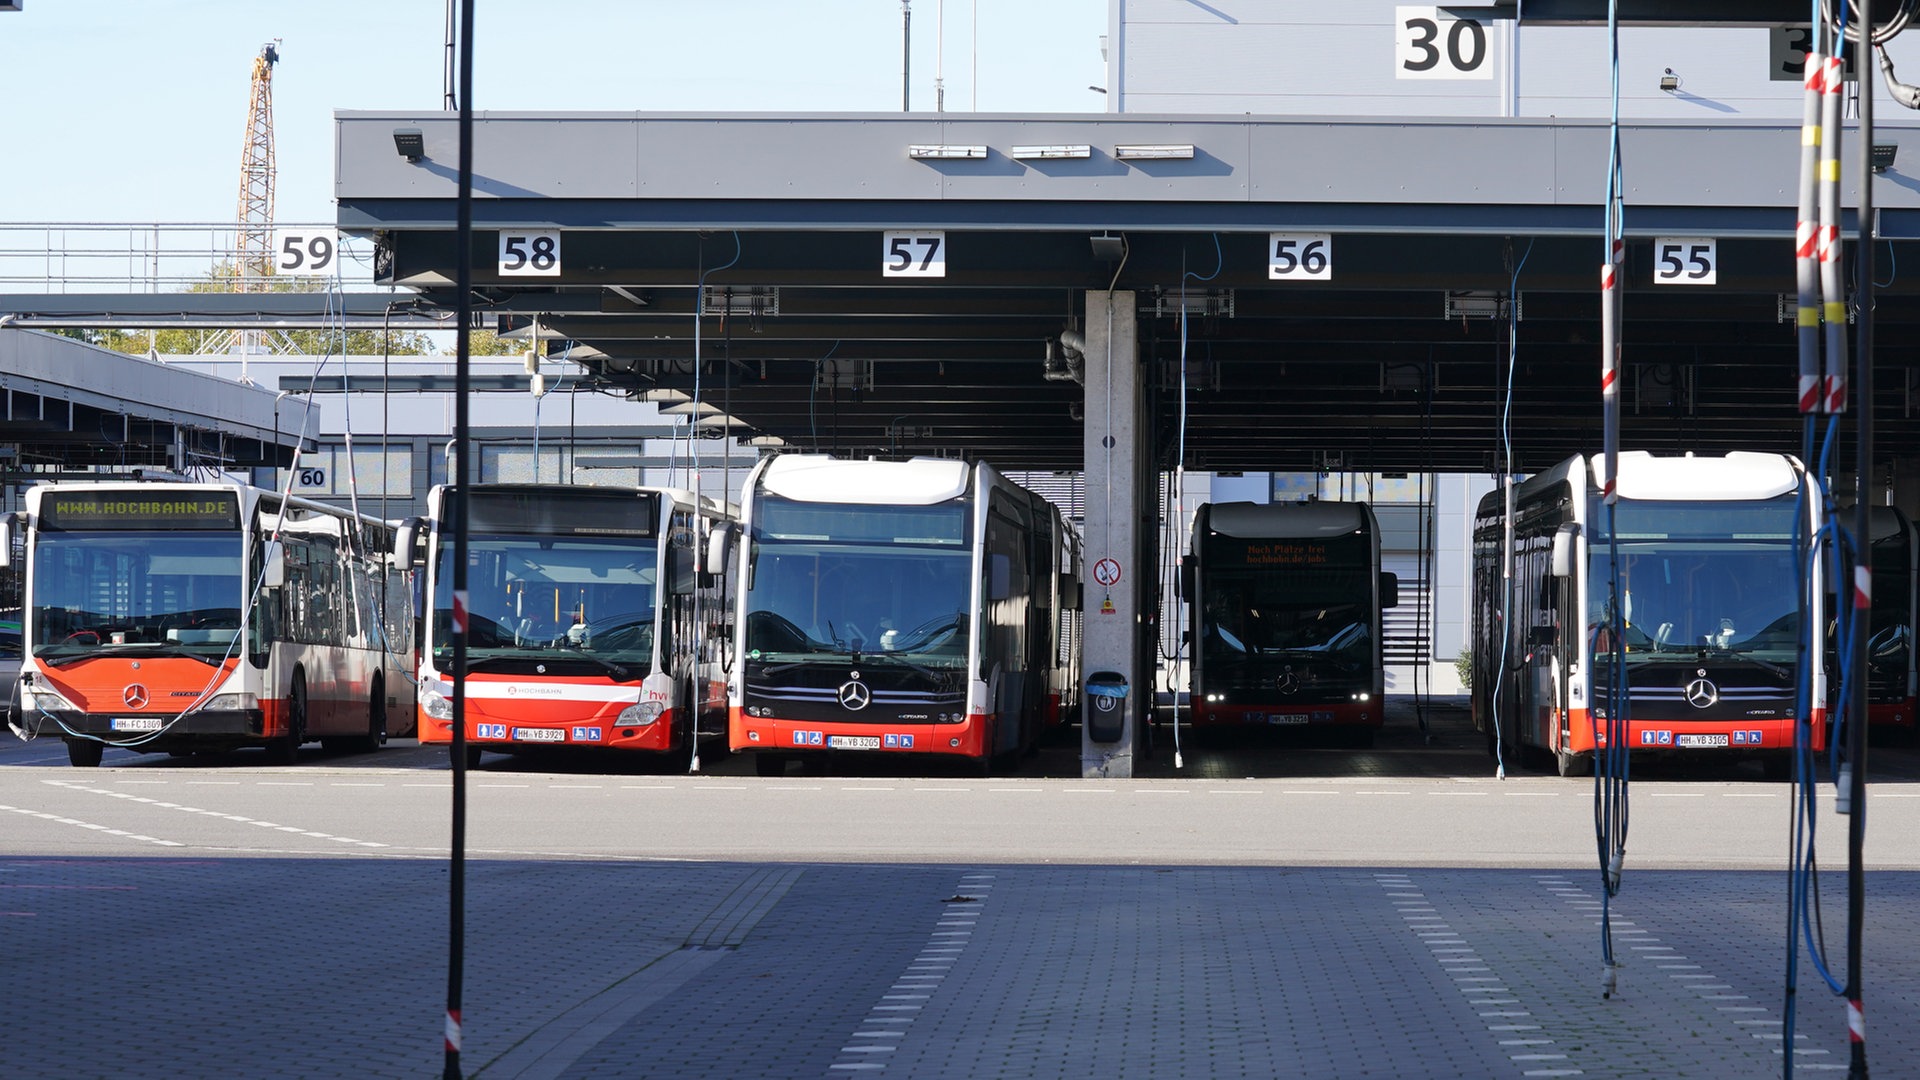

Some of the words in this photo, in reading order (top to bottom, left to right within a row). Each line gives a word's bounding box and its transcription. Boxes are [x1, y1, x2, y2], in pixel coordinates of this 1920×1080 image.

[1404, 18, 1486, 72] 30
[1782, 28, 1853, 74] 3
[281, 236, 332, 270] 59
[504, 236, 556, 270] 58
[889, 238, 941, 272] 57
[1274, 240, 1327, 274] 56
[1660, 245, 1711, 279] 55
[300, 470, 324, 486] 60
[56, 501, 227, 514] WWW.HOCHBAHN.DE
[518, 687, 562, 696] HOCHBAHN
[116, 720, 127, 728] HH
[131, 720, 141, 728] FC
[518, 729, 528, 738] HH
[545, 730, 563, 739] 3929
[832, 737, 843, 746] HH
[1680, 736, 1691, 744] HH
